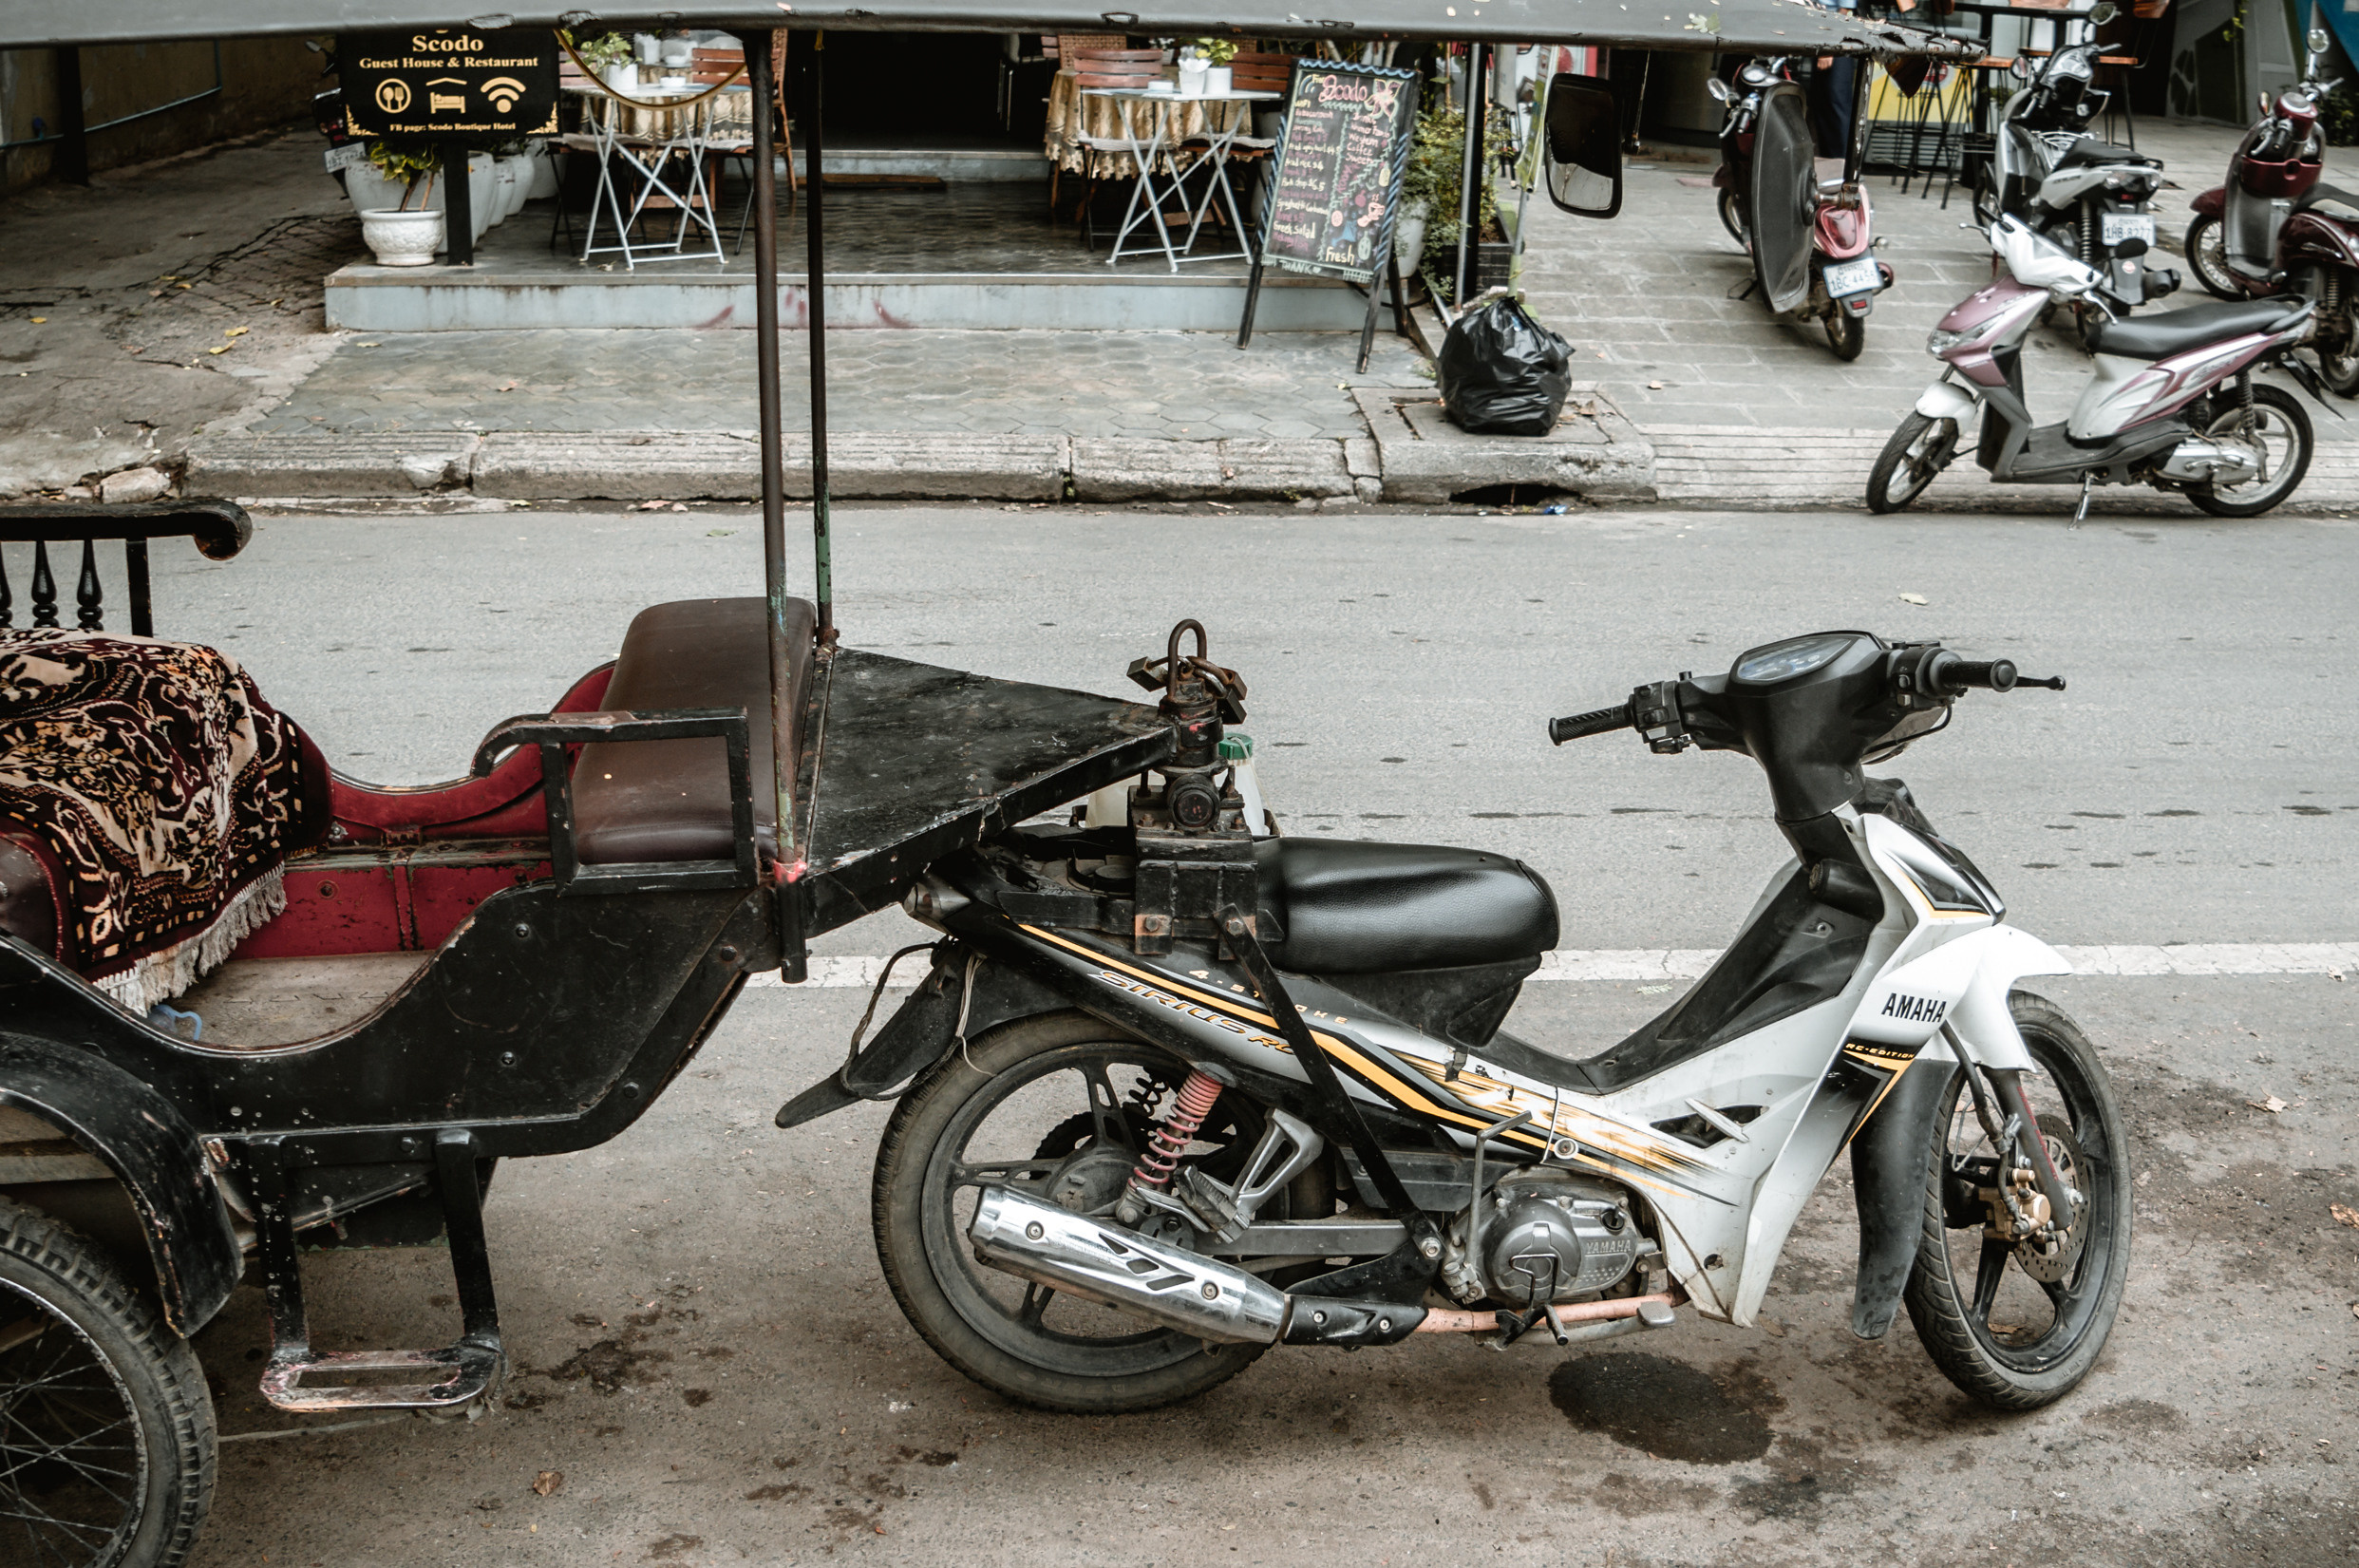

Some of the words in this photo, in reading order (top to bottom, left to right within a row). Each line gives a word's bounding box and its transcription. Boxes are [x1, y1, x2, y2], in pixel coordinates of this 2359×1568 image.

[412, 34, 483, 52] Scodo
[359, 57, 399, 68] Guest
[403, 57, 443, 68] House
[447, 57, 461, 68] &
[464, 57, 538, 68] Restaurant
[405, 124, 426, 133] page:
[455, 123, 491, 132] Boutique
[1088, 970, 1254, 1035] SIRIUS
[1880, 992, 1947, 1023] AMAHA
[1586, 1239, 1632, 1255] YAMAHA
